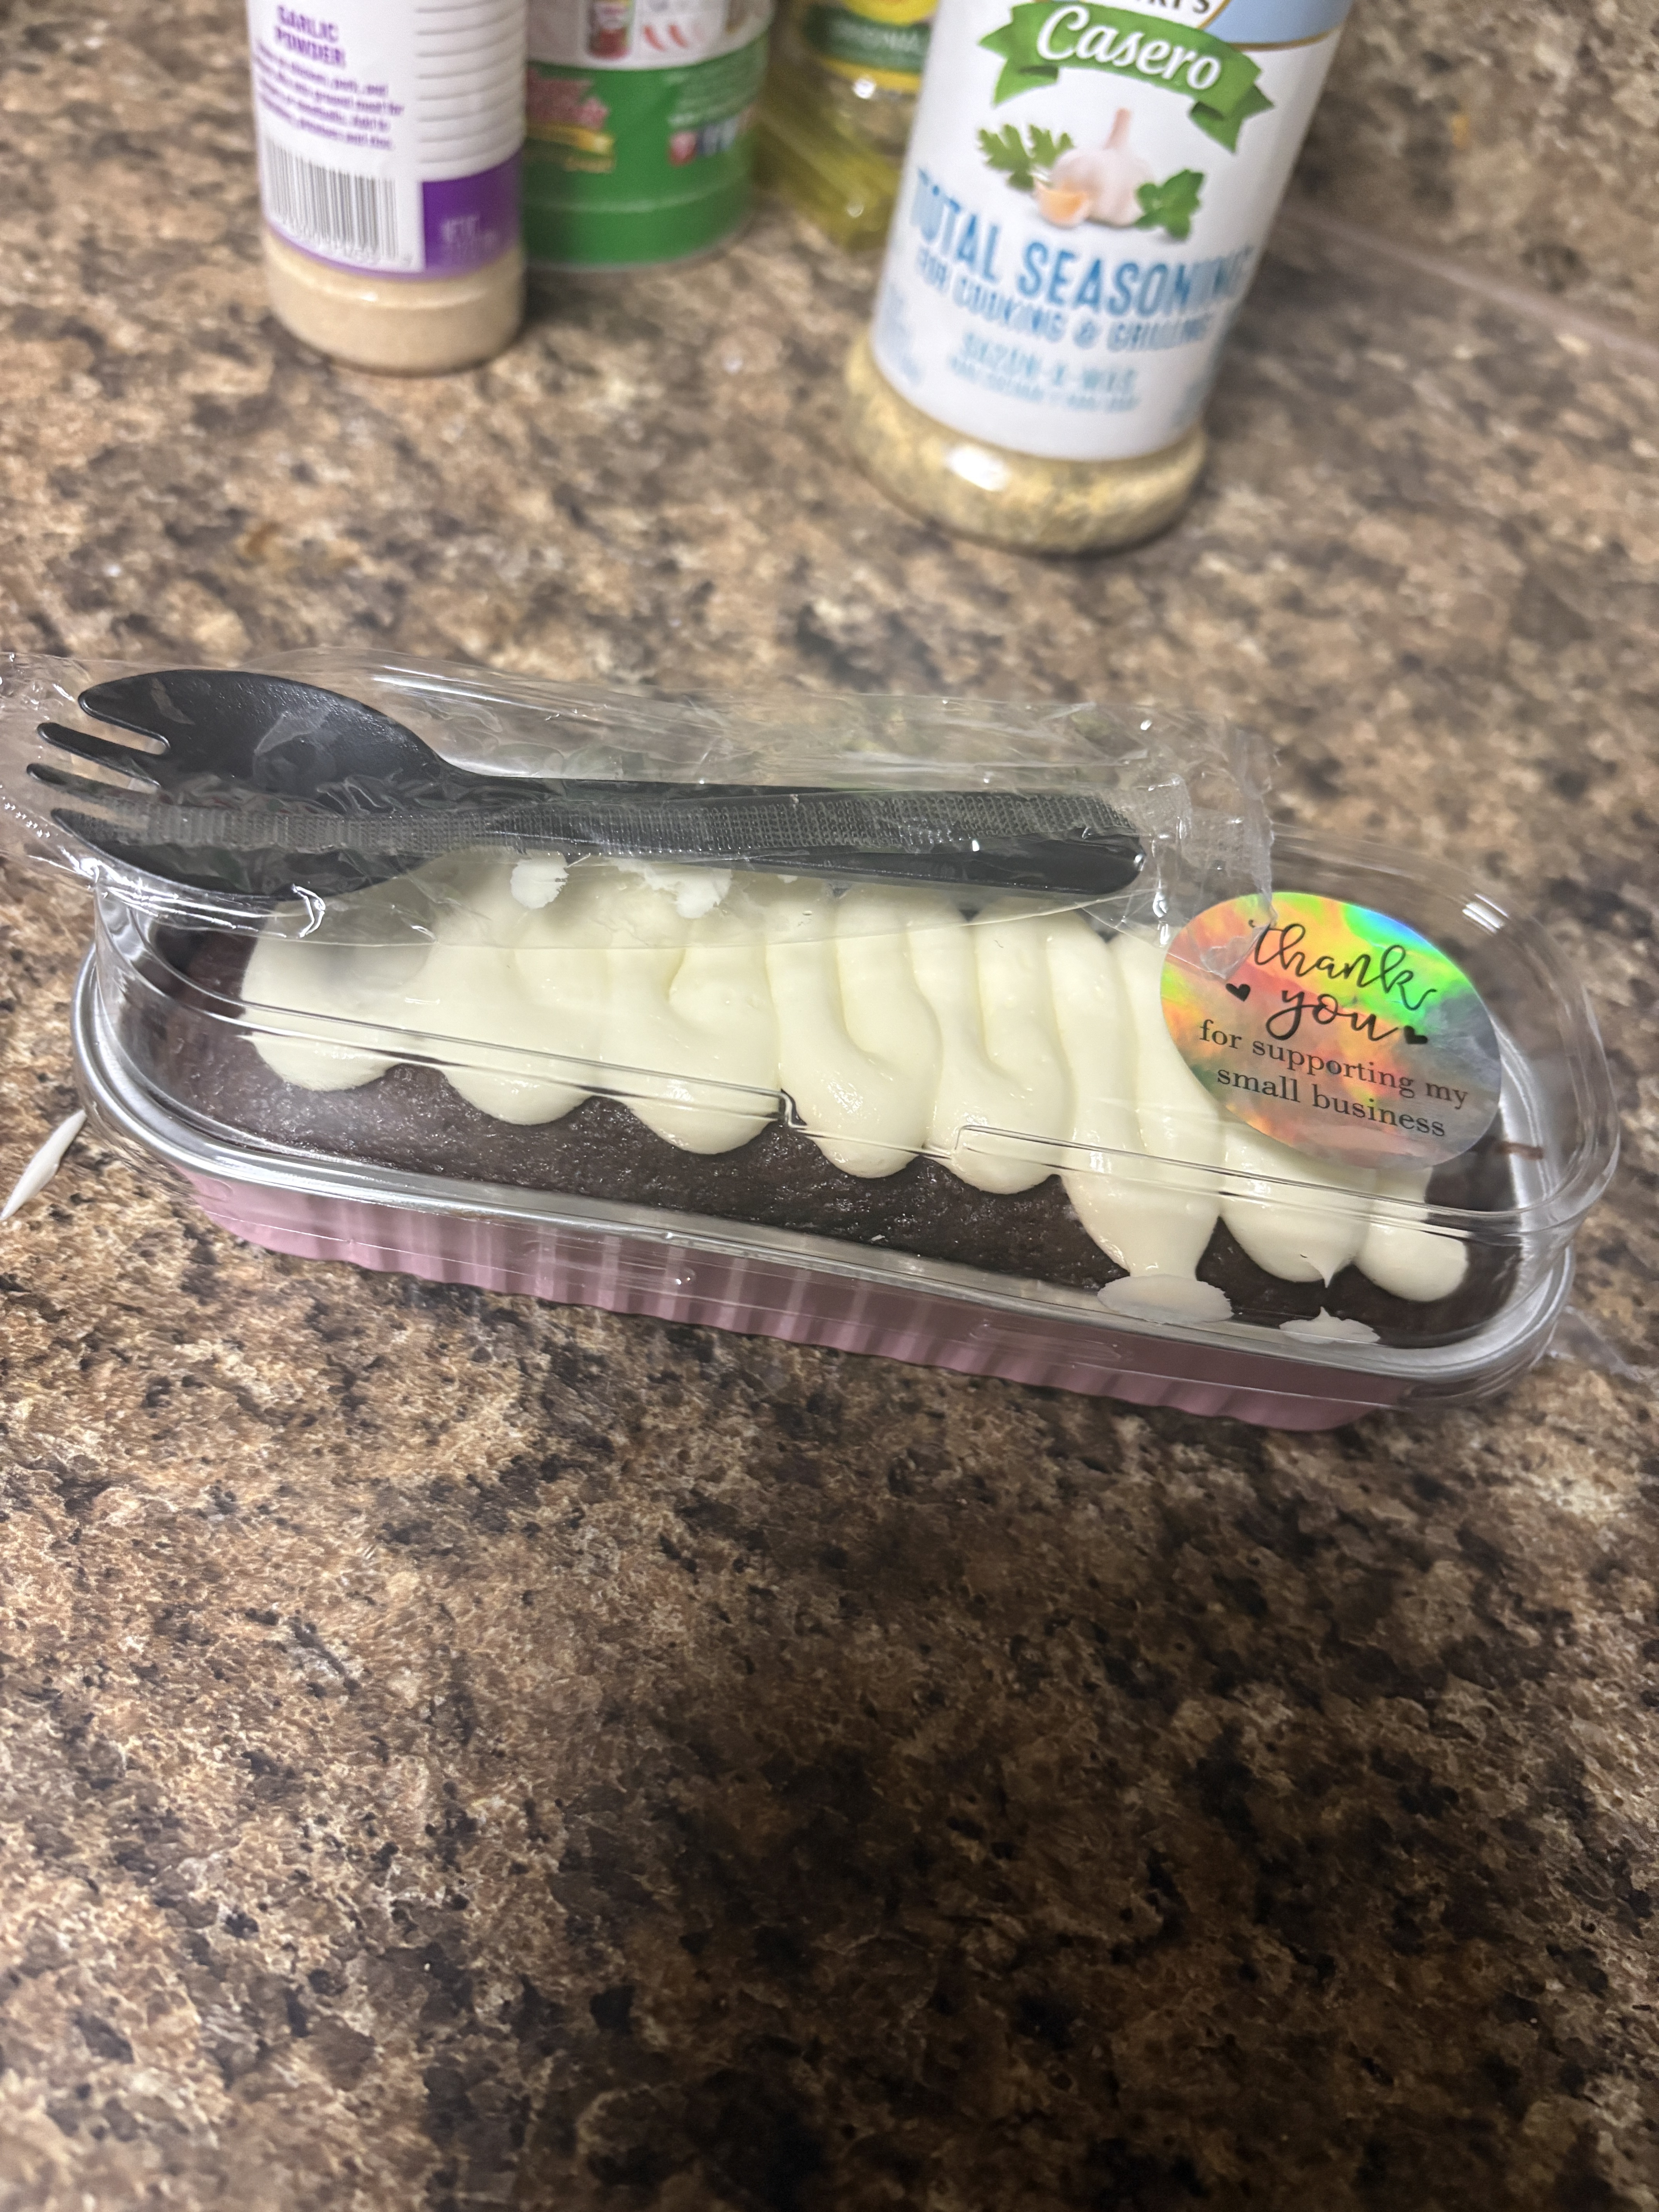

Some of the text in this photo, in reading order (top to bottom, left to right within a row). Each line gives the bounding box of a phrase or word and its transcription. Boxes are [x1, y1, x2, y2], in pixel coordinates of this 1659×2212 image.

[274, 25, 346, 69] POWDER
[278, 5, 339, 42] GARLIC
[1037, 5, 1221, 90] Casero
[1248, 919, 1437, 1011] thank
[1266, 989, 1400, 1041] you
[1200, 1019, 1468, 1110] for supporting my
[1217, 1067, 1446, 1137] small business
